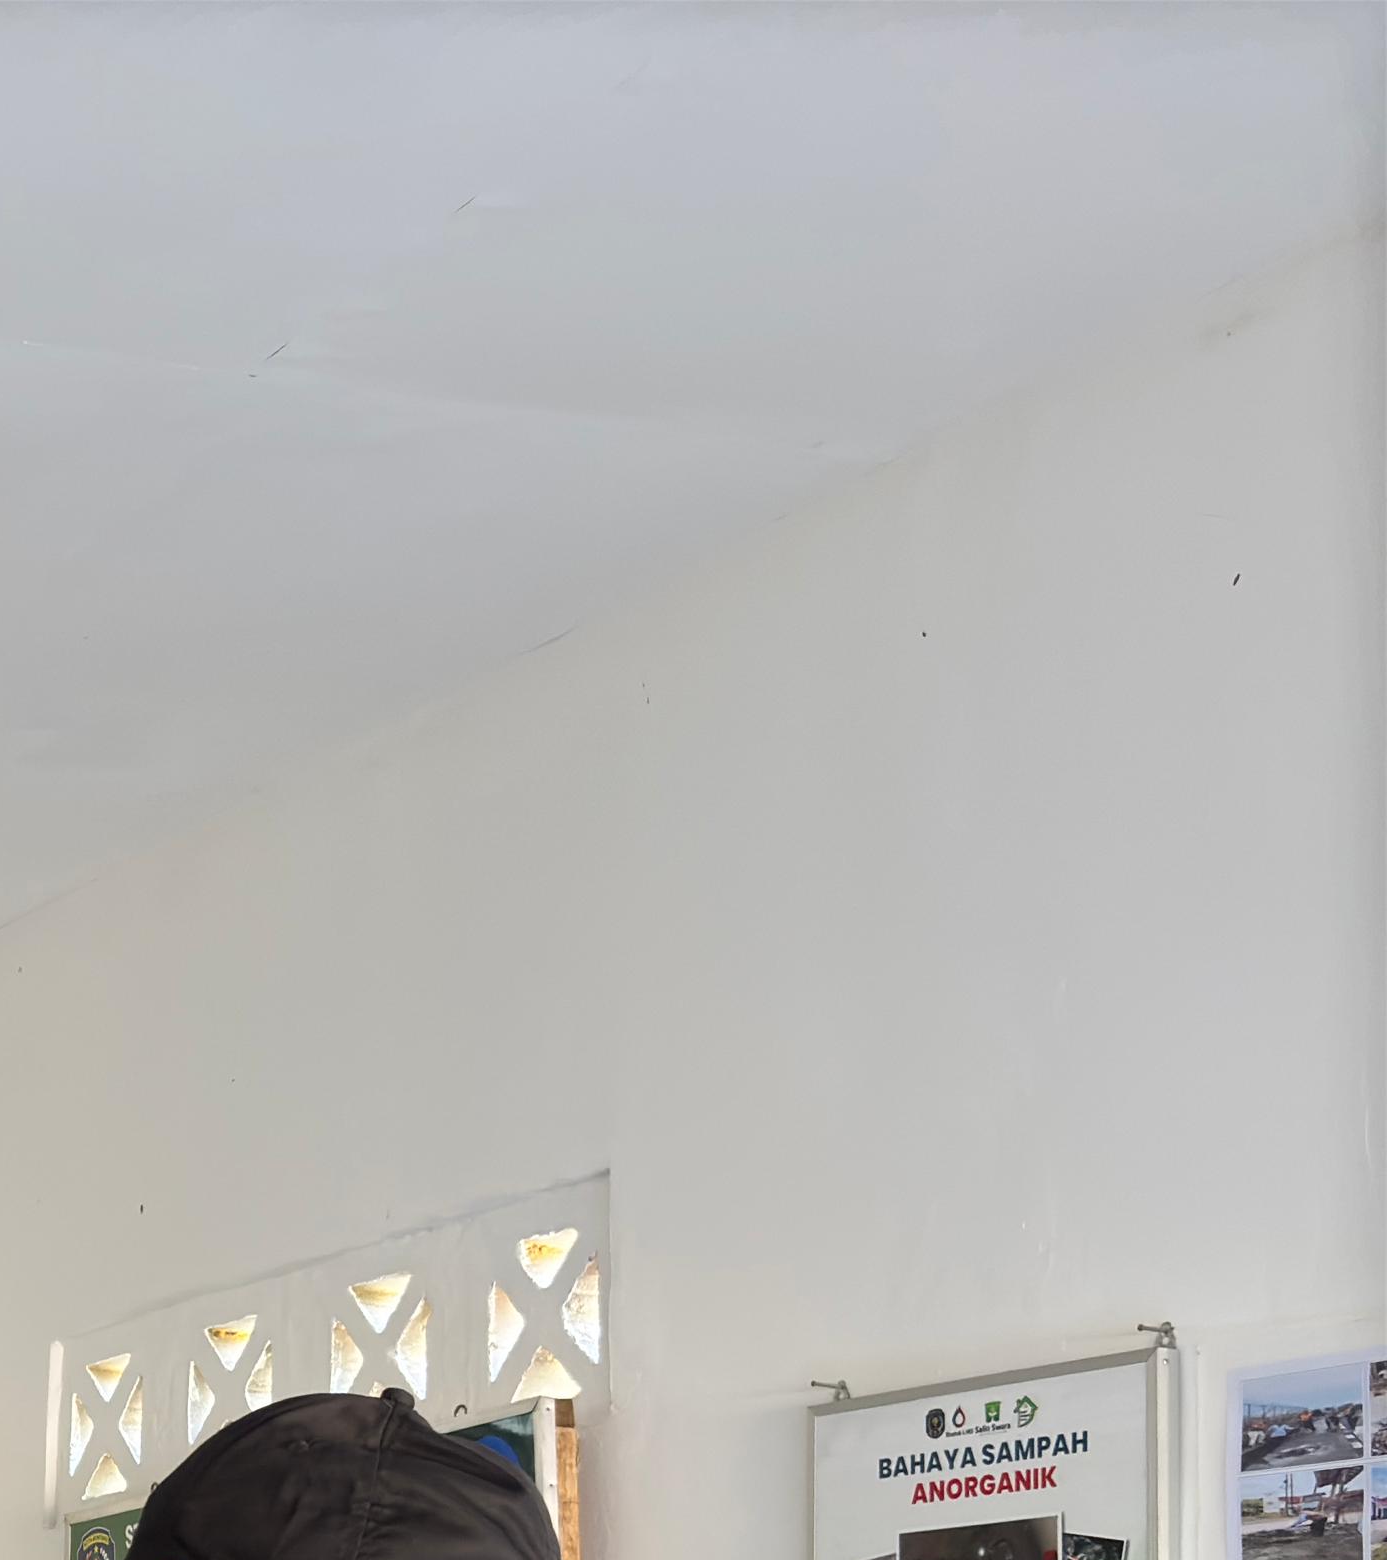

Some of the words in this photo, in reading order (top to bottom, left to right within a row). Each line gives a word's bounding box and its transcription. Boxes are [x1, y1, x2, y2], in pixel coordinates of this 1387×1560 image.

[878, 1447, 977, 1480] BAHAYA
[982, 1430, 1089, 1466] SAMPAH
[911, 1466, 1057, 1504] ANORGANIK
